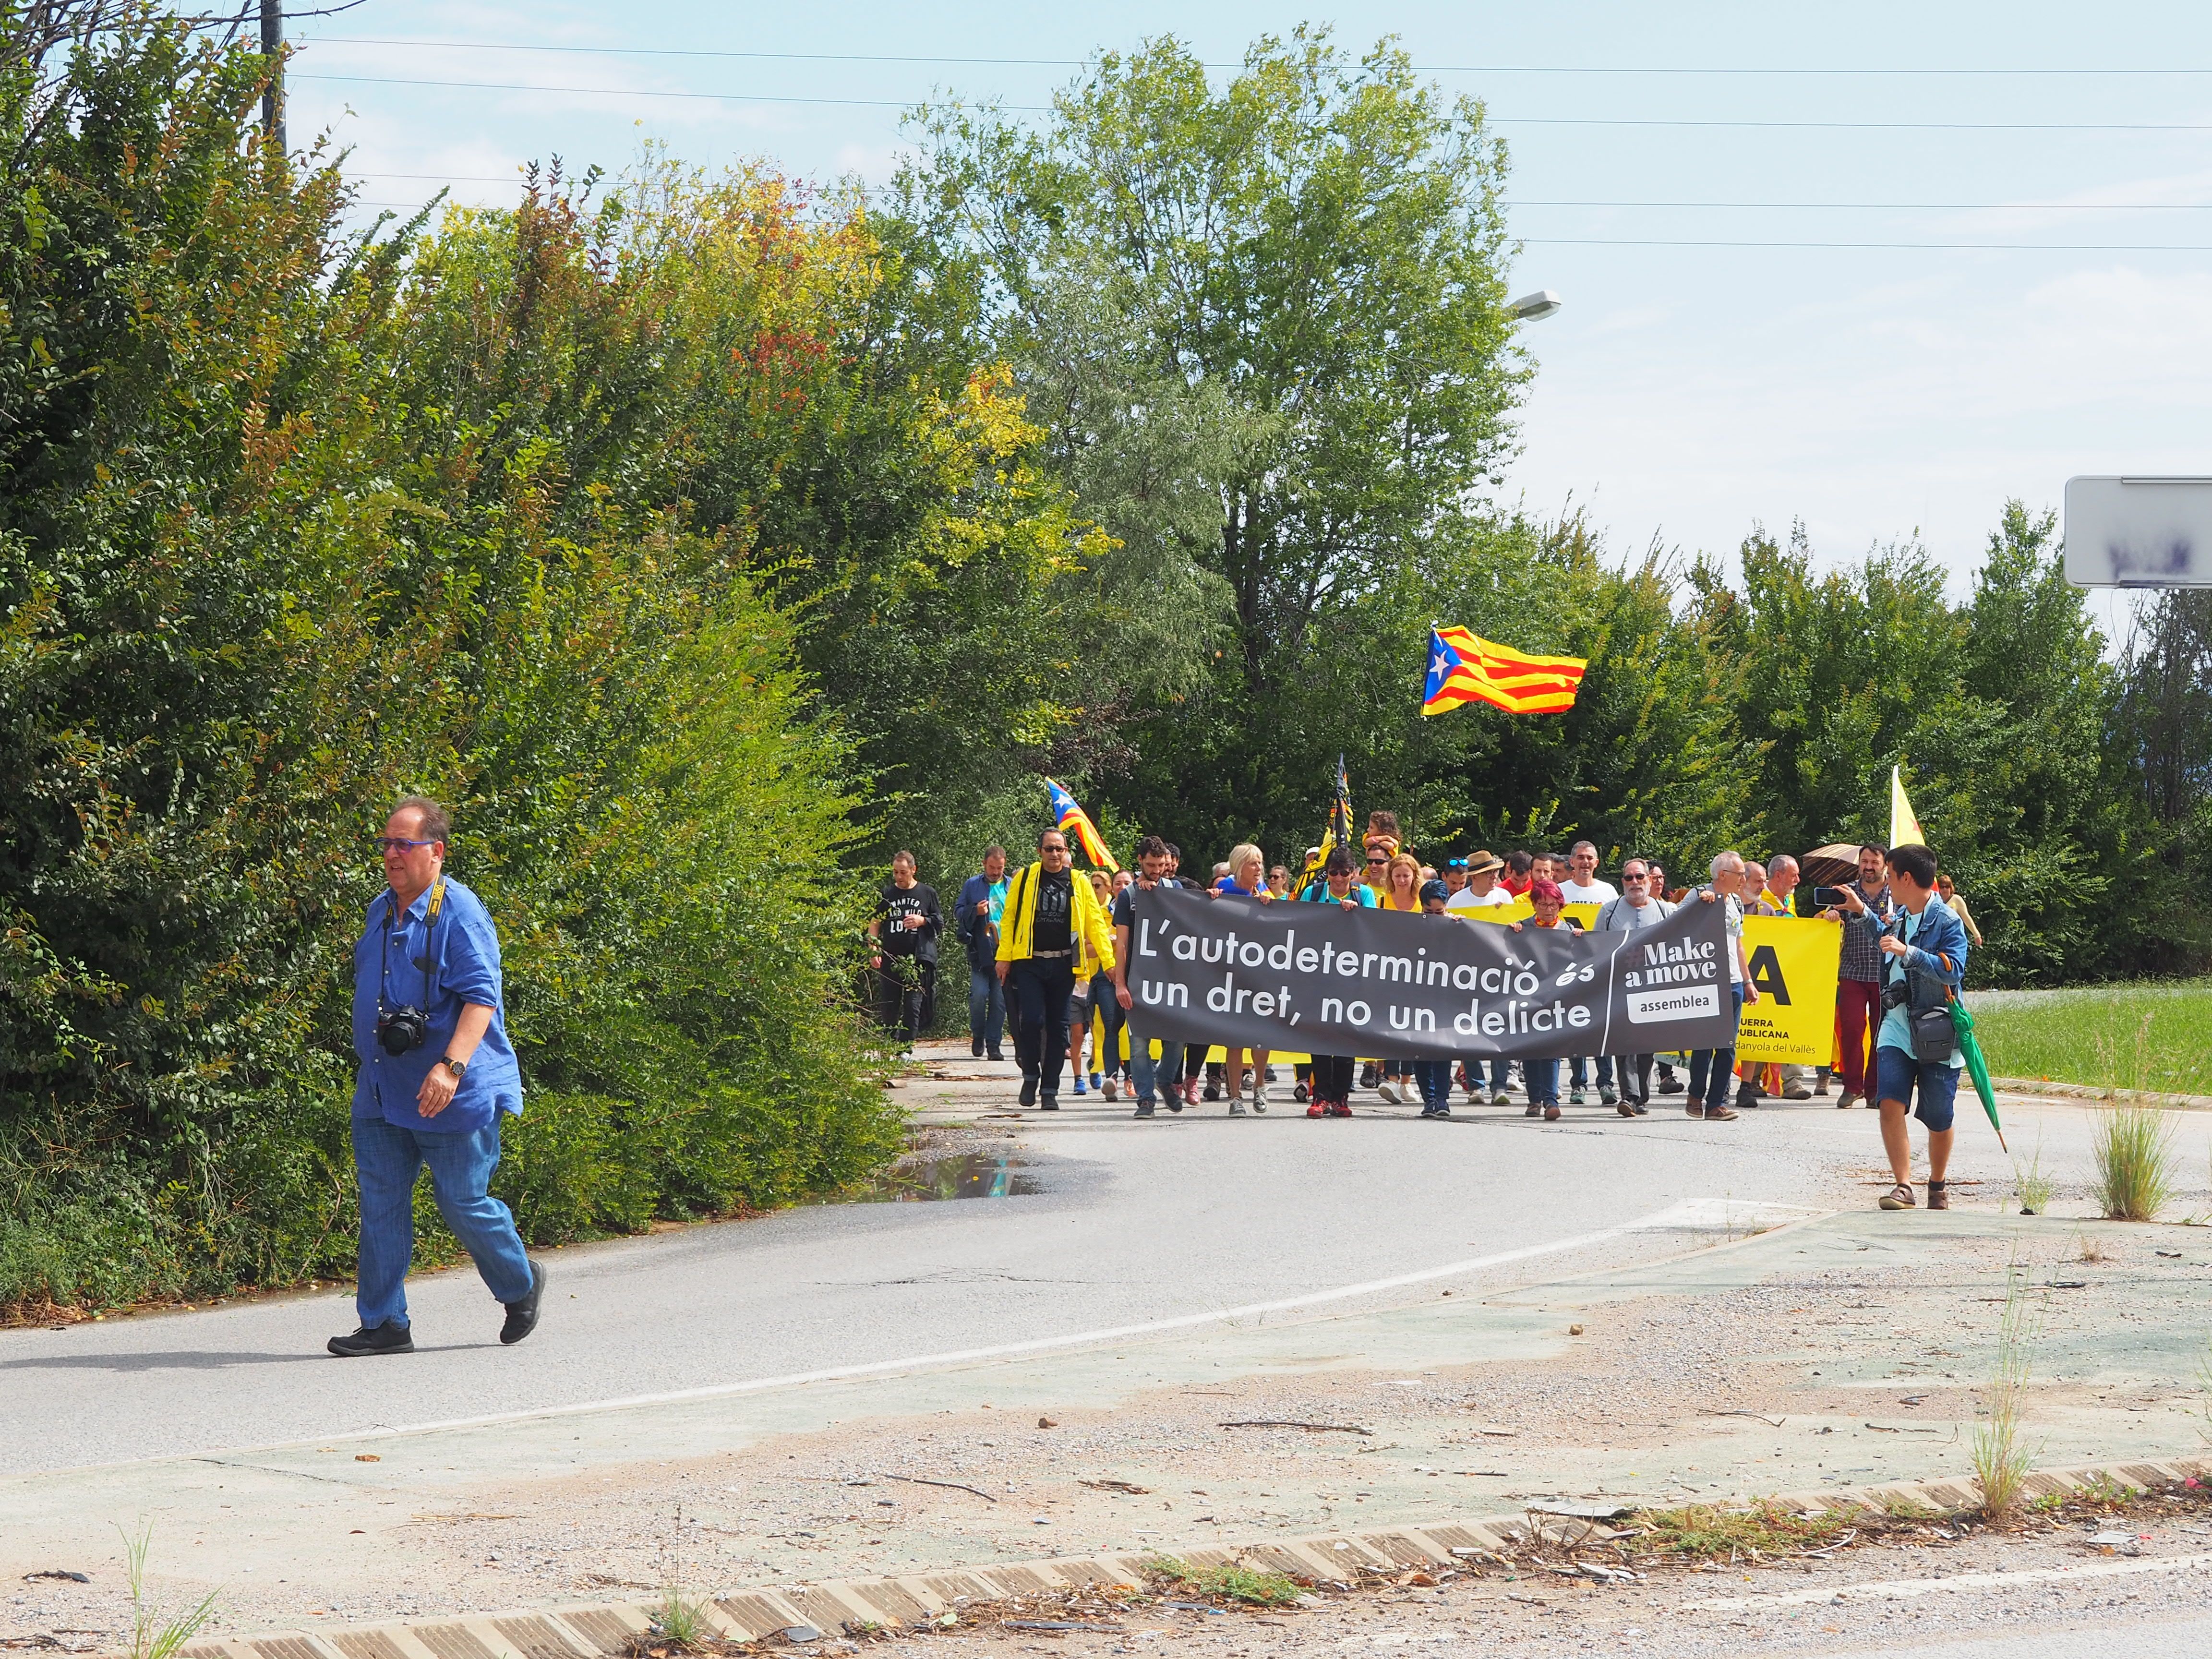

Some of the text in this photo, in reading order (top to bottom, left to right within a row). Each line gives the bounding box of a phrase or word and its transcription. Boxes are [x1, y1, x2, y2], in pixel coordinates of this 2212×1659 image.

[890, 898, 920, 907] WANTED
[905, 909, 922, 917] WILD
[890, 920, 917, 933] LO
[1140, 919, 1595, 996] L'autodeterminació és
[1625, 962, 1717, 987] a move
[1142, 972, 1591, 1035] un dret, no un delicte
[1640, 995, 1709, 1012] assemblea
[1773, 1043, 1787, 1052] del
[1790, 1044, 1815, 1054] Vallès
